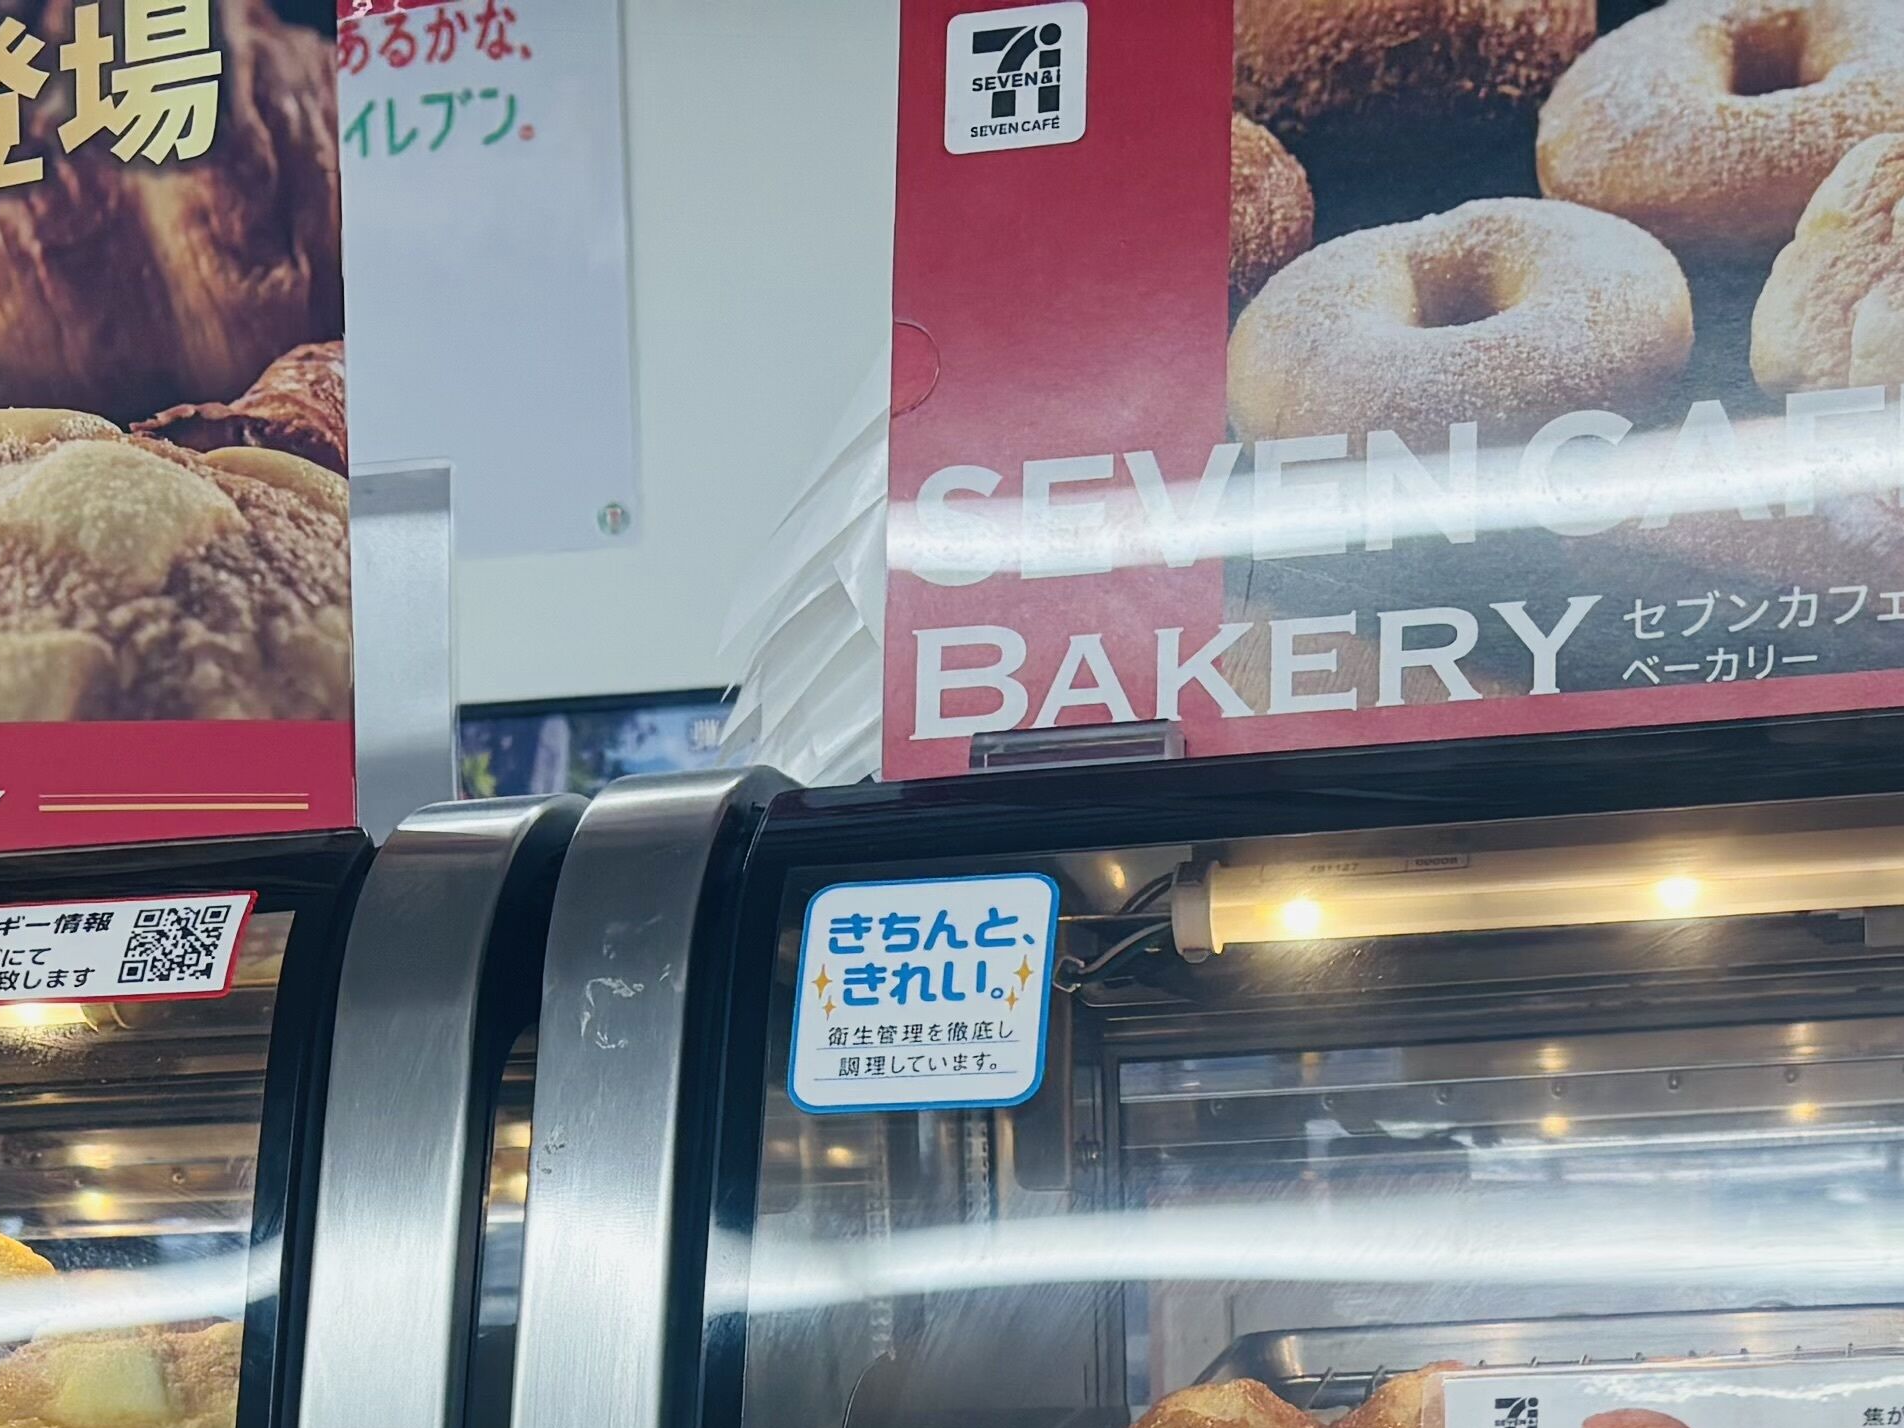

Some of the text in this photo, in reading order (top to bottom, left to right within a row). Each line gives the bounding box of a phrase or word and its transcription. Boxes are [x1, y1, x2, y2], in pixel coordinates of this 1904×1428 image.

[970, 115, 1060, 138] SEVEN CAFÉ
[913, 422, 1476, 587] SEVEN
[909, 593, 1603, 741] BAKERY
[1622, 645, 1819, 685] ベーカリー
[828, 907, 1036, 955] きちんと、
[842, 960, 1005, 1007] きれい。
[827, 1021, 1014, 1048] 衛生管理を徹底し
[838, 1051, 998, 1077] 調理しています。
